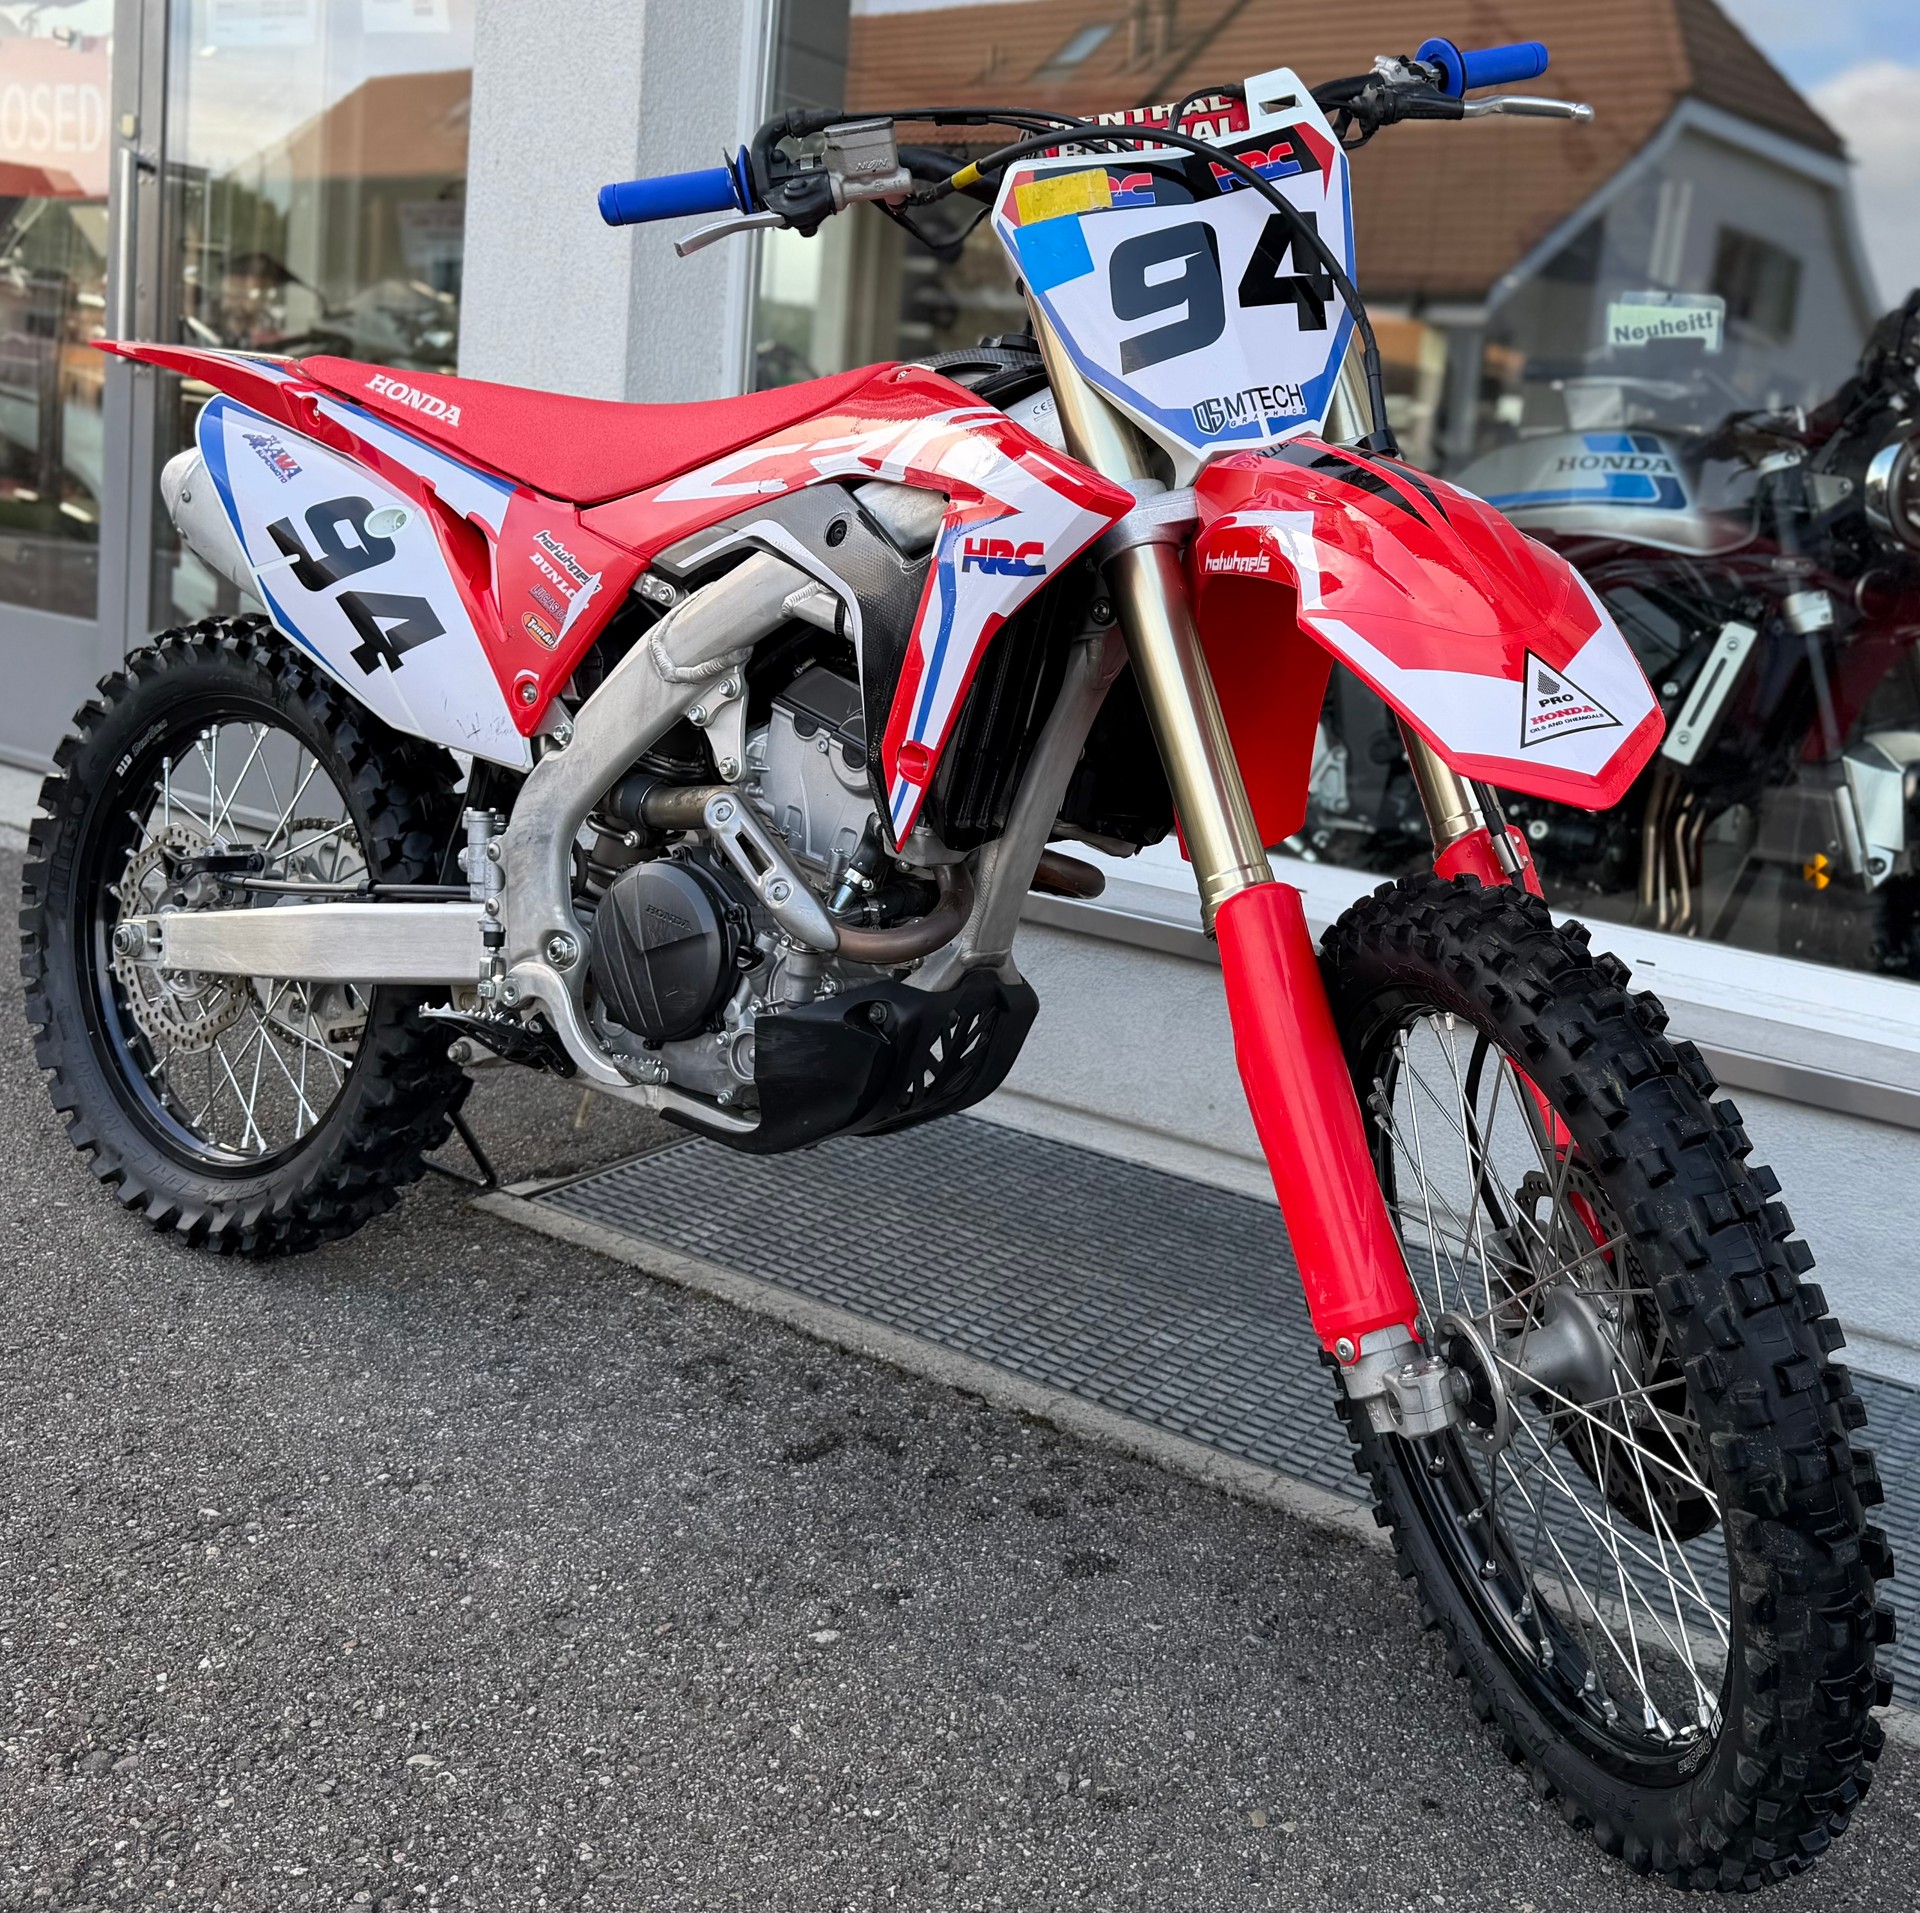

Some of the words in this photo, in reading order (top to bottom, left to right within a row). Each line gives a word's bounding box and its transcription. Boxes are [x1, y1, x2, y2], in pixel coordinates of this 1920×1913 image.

[1109, 211, 1336, 376] 94
[1614, 311, 1713, 342] Neuheit!
[365, 373, 461, 428] HONDA
[1230, 407, 1306, 427] GRAPHICS
[1556, 455, 1674, 473] HONDA
[961, 537, 1047, 577] HRC
[266, 496, 447, 676] 94
[529, 552, 588, 609] DUNLO
[1530, 705, 1596, 725] HONDA
[1538, 694, 1574, 708] PRO
[1530, 725, 1546, 734] OILS
[1548, 720, 1563, 729] AND
